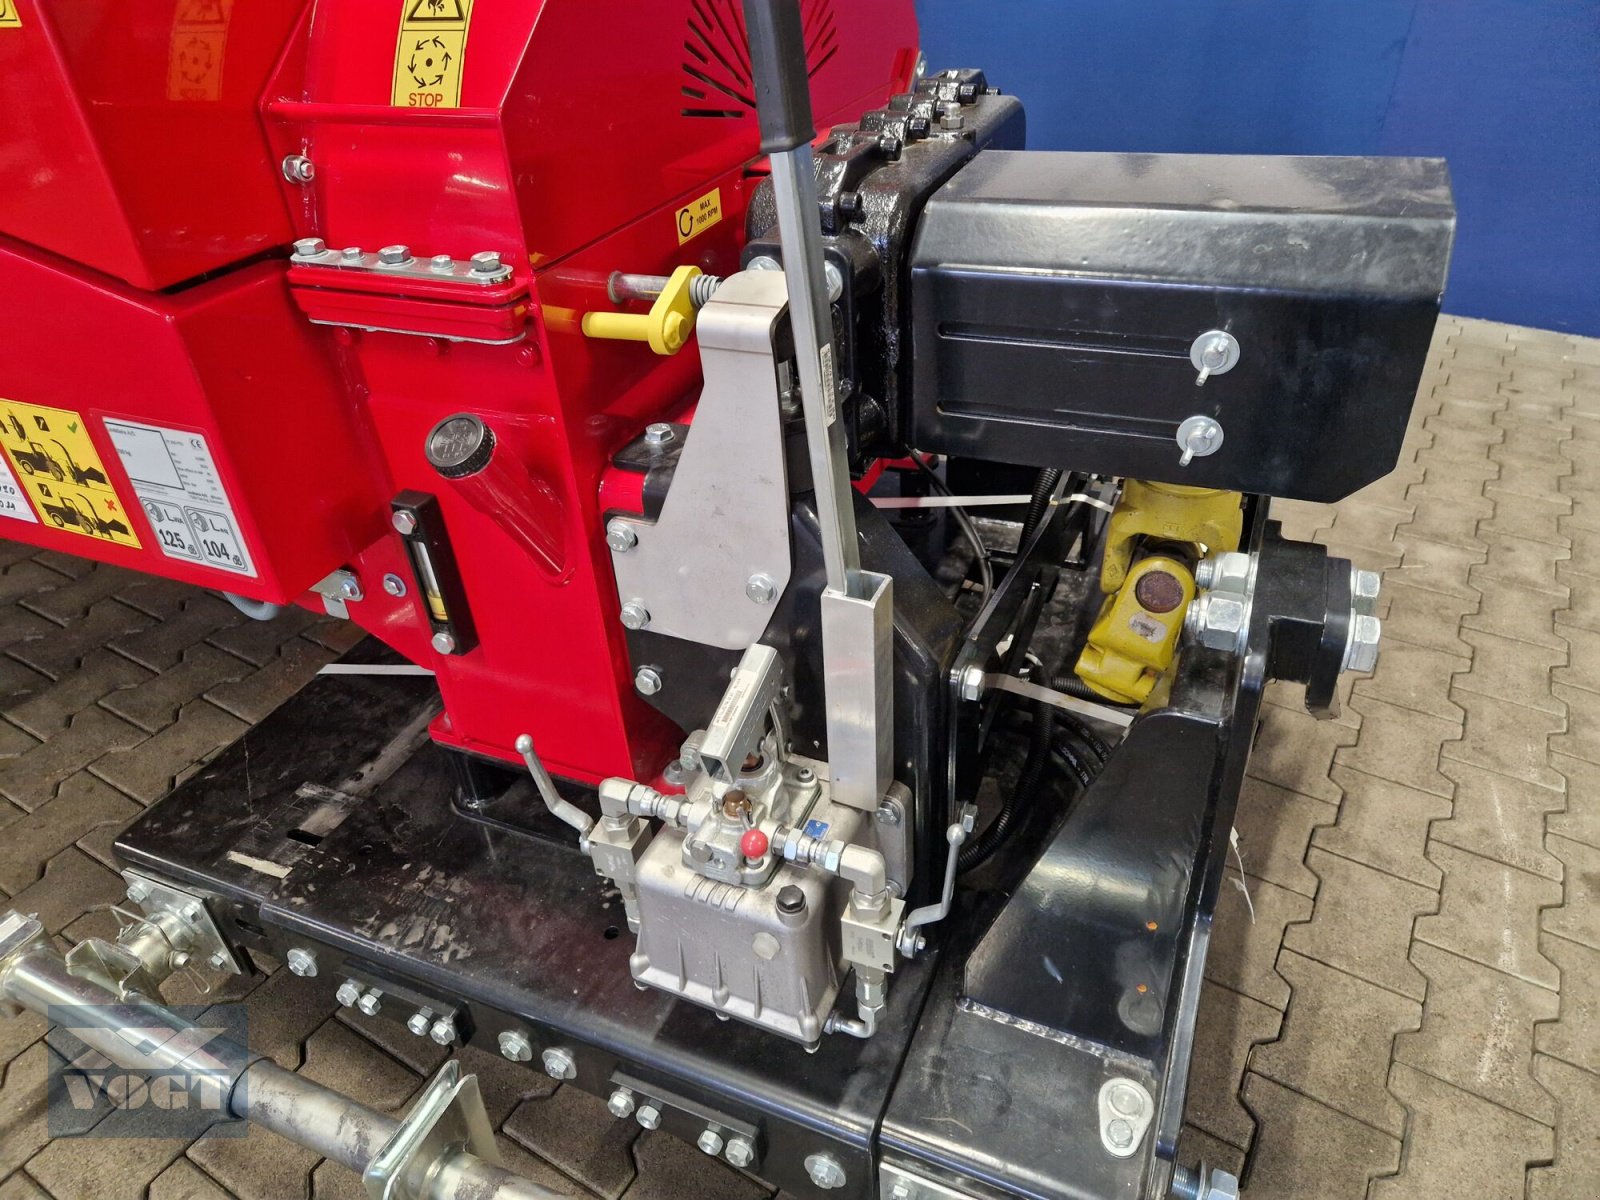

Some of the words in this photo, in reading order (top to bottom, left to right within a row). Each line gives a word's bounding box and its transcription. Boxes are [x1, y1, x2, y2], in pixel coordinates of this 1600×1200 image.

[408, 92, 443, 107] STOP
[699, 199, 711, 211] MAX
[696, 213, 708, 226] 1000
[707, 206, 718, 219] RPM
[159, 529, 185, 550] 125
[203, 539, 231, 560] 104
